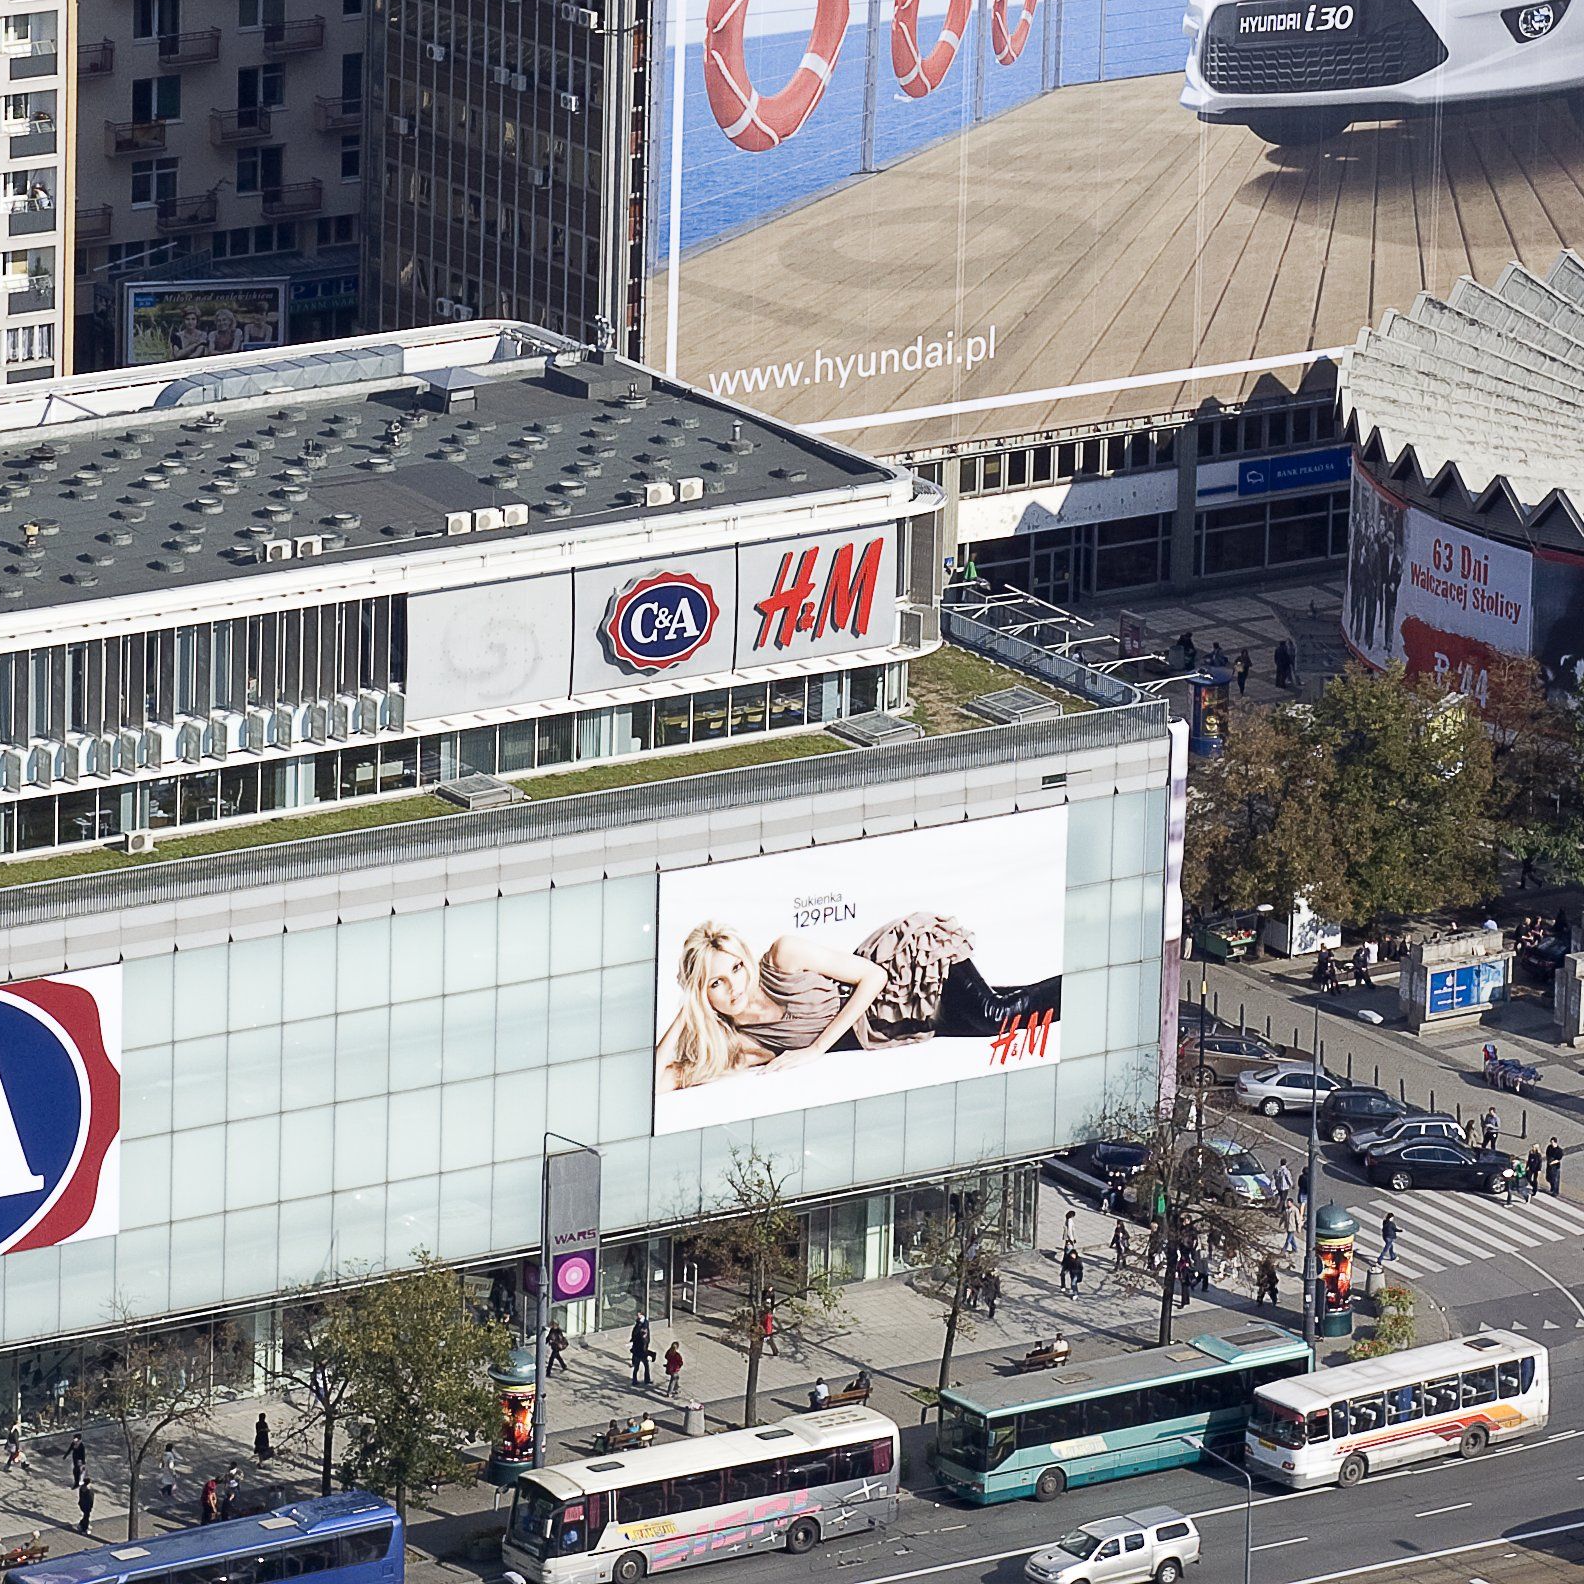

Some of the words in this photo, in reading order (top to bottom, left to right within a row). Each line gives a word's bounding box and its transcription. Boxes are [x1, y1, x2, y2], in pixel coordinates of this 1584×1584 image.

[1238, 13, 1302, 35] HYUNDAI
[1304, 2, 1355, 33] i30
[708, 326, 997, 397] www.hyundai.pl
[1277, 469, 1298, 478] BANK
[1299, 465, 1324, 475] PEKAO
[1325, 463, 1335, 471] SA
[1432, 538, 1453, 573] 63
[1460, 544, 1489, 586] Dni
[757, 536, 885, 650] H&M
[1411, 560, 1468, 611] Walczącej
[1472, 587, 1522, 625] Stolicy
[629, 596, 697, 645] C&A
[793, 891, 843, 911] Sukienka
[793, 905, 822, 929] 129
[823, 901, 858, 926] PLN
[989, 1005, 1055, 1067] H&M
[554, 1228, 596, 1245] WARS
